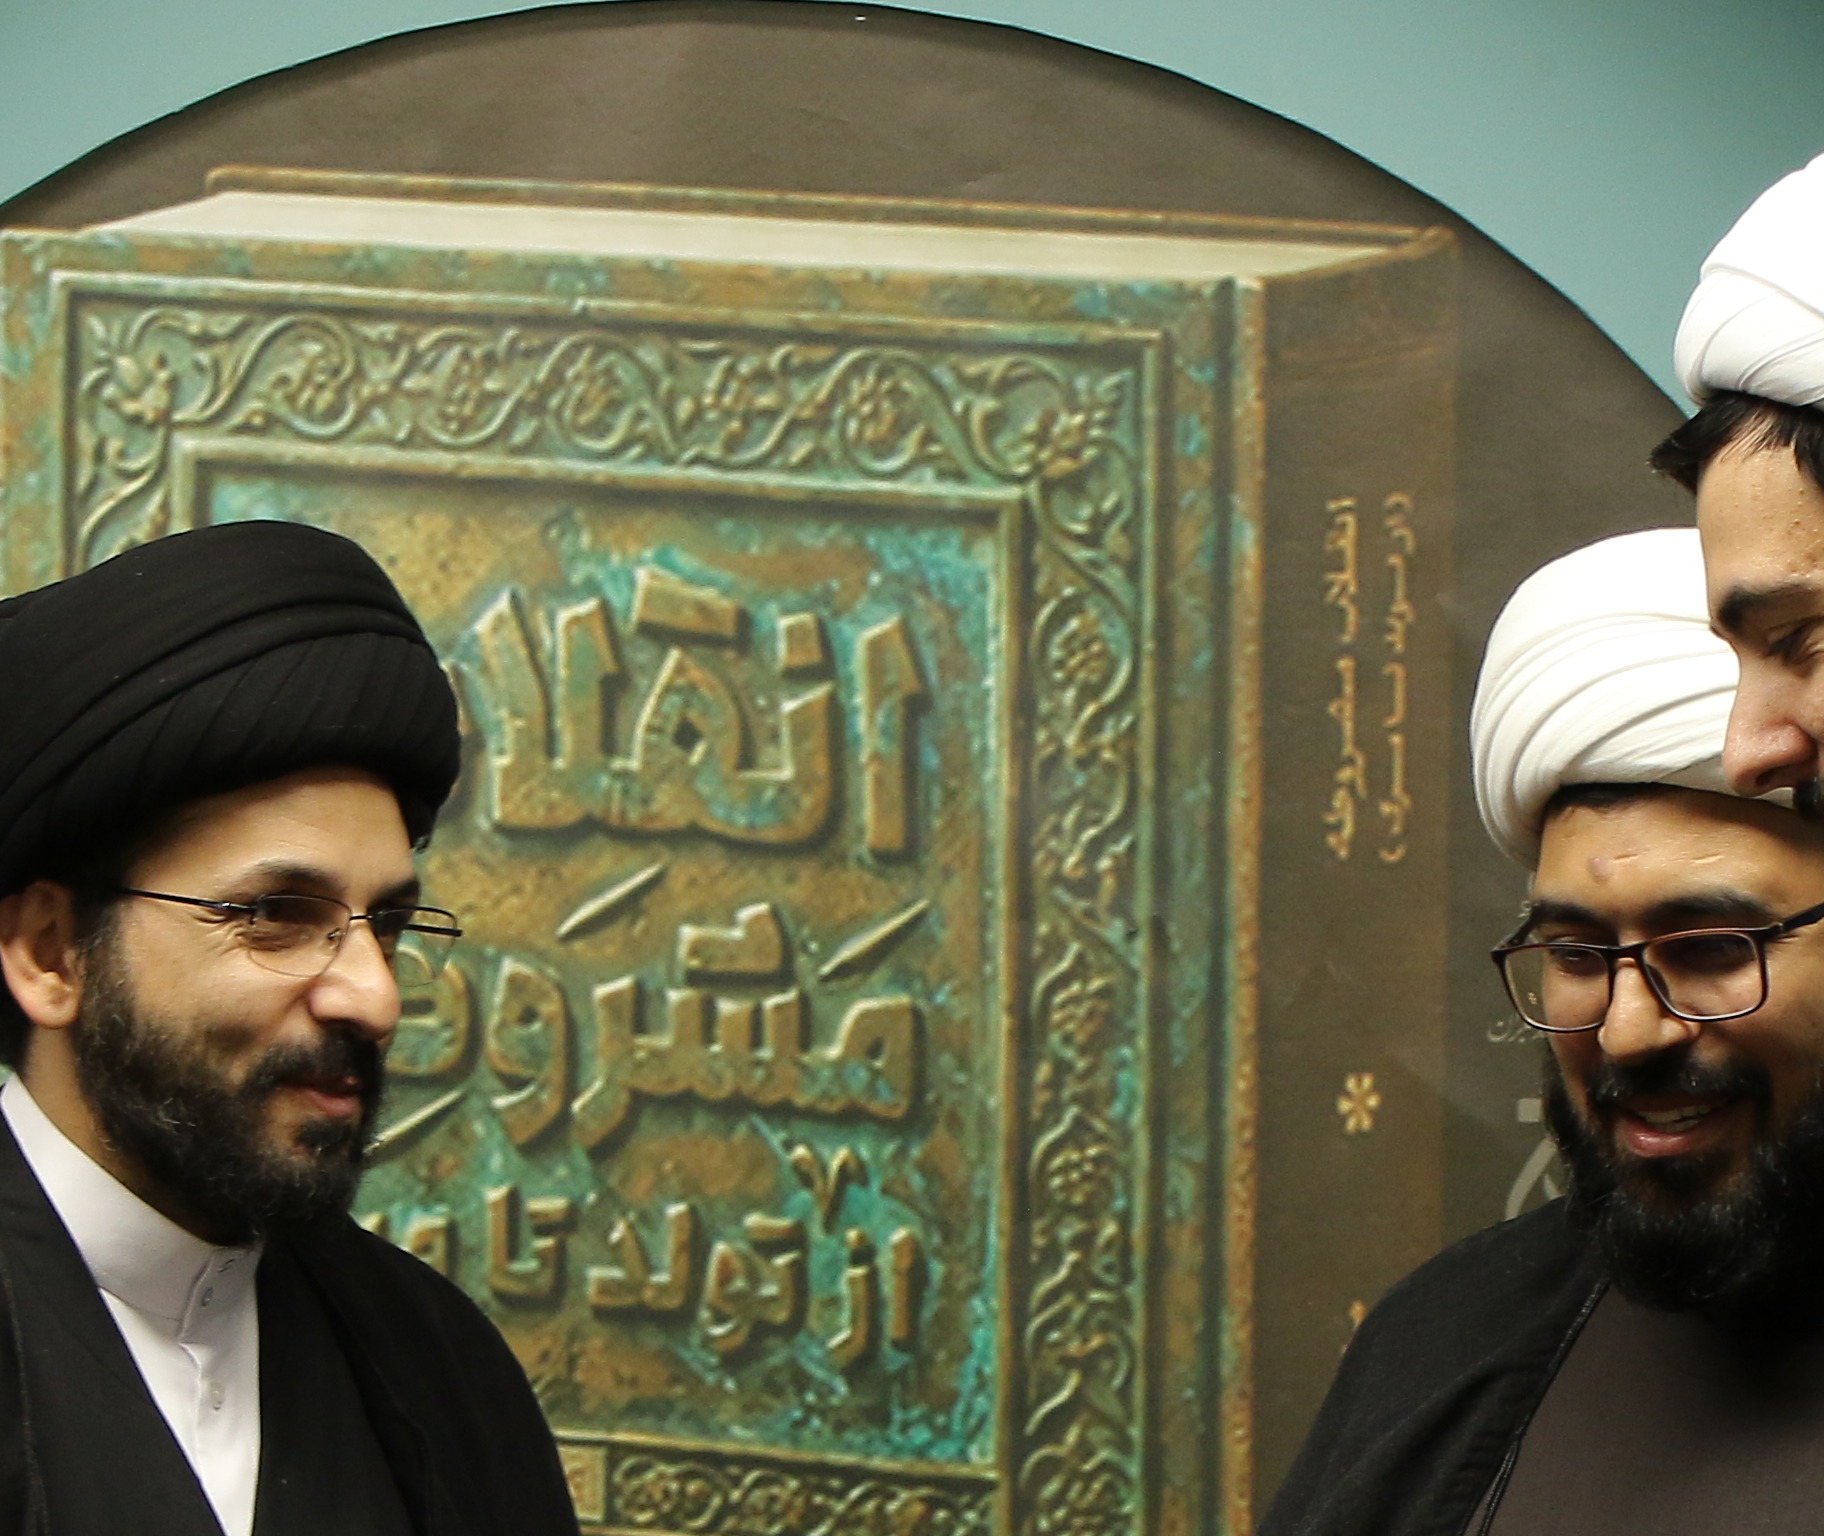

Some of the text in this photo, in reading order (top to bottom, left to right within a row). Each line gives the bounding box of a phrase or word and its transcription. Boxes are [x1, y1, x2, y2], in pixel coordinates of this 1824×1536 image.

[441, 566, 928, 852] انقلا
[484, 1182, 572, 1296] تا
[587, 1200, 802, 1355] تولد
